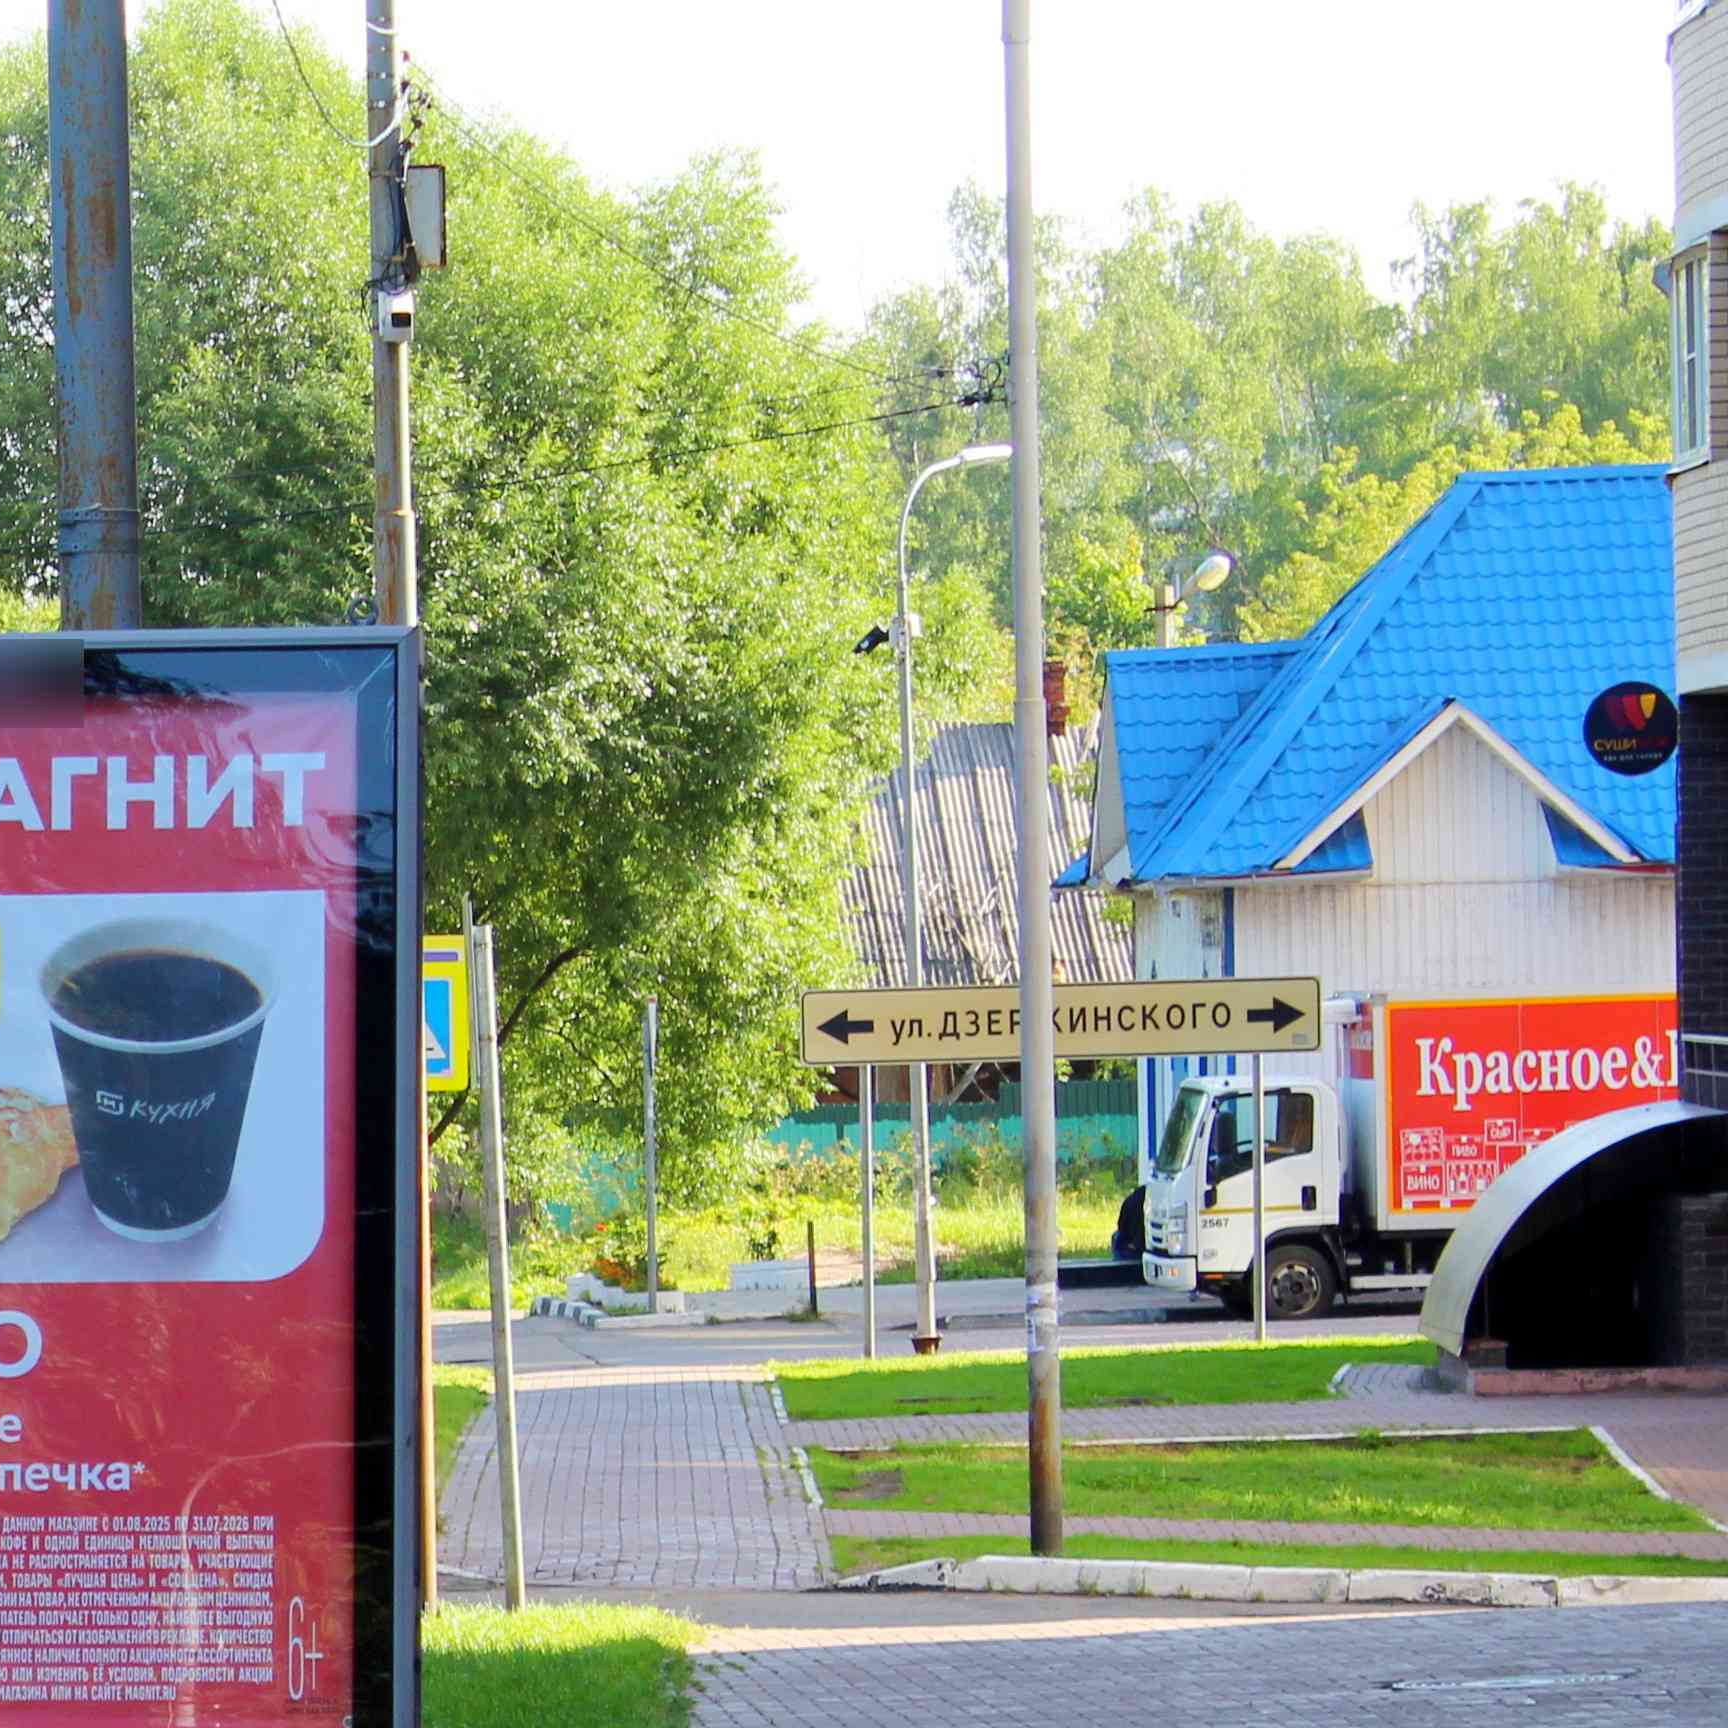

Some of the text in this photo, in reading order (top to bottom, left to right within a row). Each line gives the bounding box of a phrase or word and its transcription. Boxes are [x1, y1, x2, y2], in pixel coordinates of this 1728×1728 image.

[129, 1091, 216, 1124] КУХНЯ
[1407, 1175, 1440, 1191] ВИНО
[2, 1516, 44, 1533] ДАННОМ
[49, 1516, 97, 1531] МАГАЗИНЕ
[113, 1516, 170, 1531] 01.08.2025
[192, 1516, 249, 1531] 31.07.2026
[254, 1516, 273, 1531] ПРИ
[0, 1535, 27, 1550] КОФЕ
[44, 1533, 79, 1552] ОДНОЙ
[85, 1535, 134, 1552] ЕДИНИЦЫ
[226, 1535, 273, 1550] ВЫПЕЧКИ
[29, 1554, 127, 1568] РАСПРОСТРАНЯЕТСЯ
[197, 1554, 273, 1570] УЧАСТВУЮЩИЕ
[12, 1573, 52, 1587] ТОВАРЫ
[233, 1573, 273, 1589] СКИДКА
[38, 1610, 89, 1625] ПОЛУЧАЕТ
[91, 1610, 129, 1625] ТОЛЬКО
[162, 1610, 214, 1625] НАИБОЛЕЕ
[216, 1610, 273, 1626] ВЫГОДНУЮ
[34, 1648, 80, 1662] НАЛИЧИЕ
[82, 1648, 127, 1662] ПОЛНОГО
[129, 1648, 196, 1664] АКЦИОННОГО
[197, 1648, 273, 1662] АССОРТИМЕНТА
[288, 1595, 325, 1701] 6+
[12, 1667, 32, 1681] ИЛИ
[37, 1667, 89, 1681] ИЗМЕНИТЬ
[161, 1667, 235, 1683] ПОДРОБНОСТИ
[238, 1667, 273, 1683] АКЦИИ
[51, 1685, 72, 1700] ИЛИ
[91, 1683, 123, 1700] САЙТЕ
